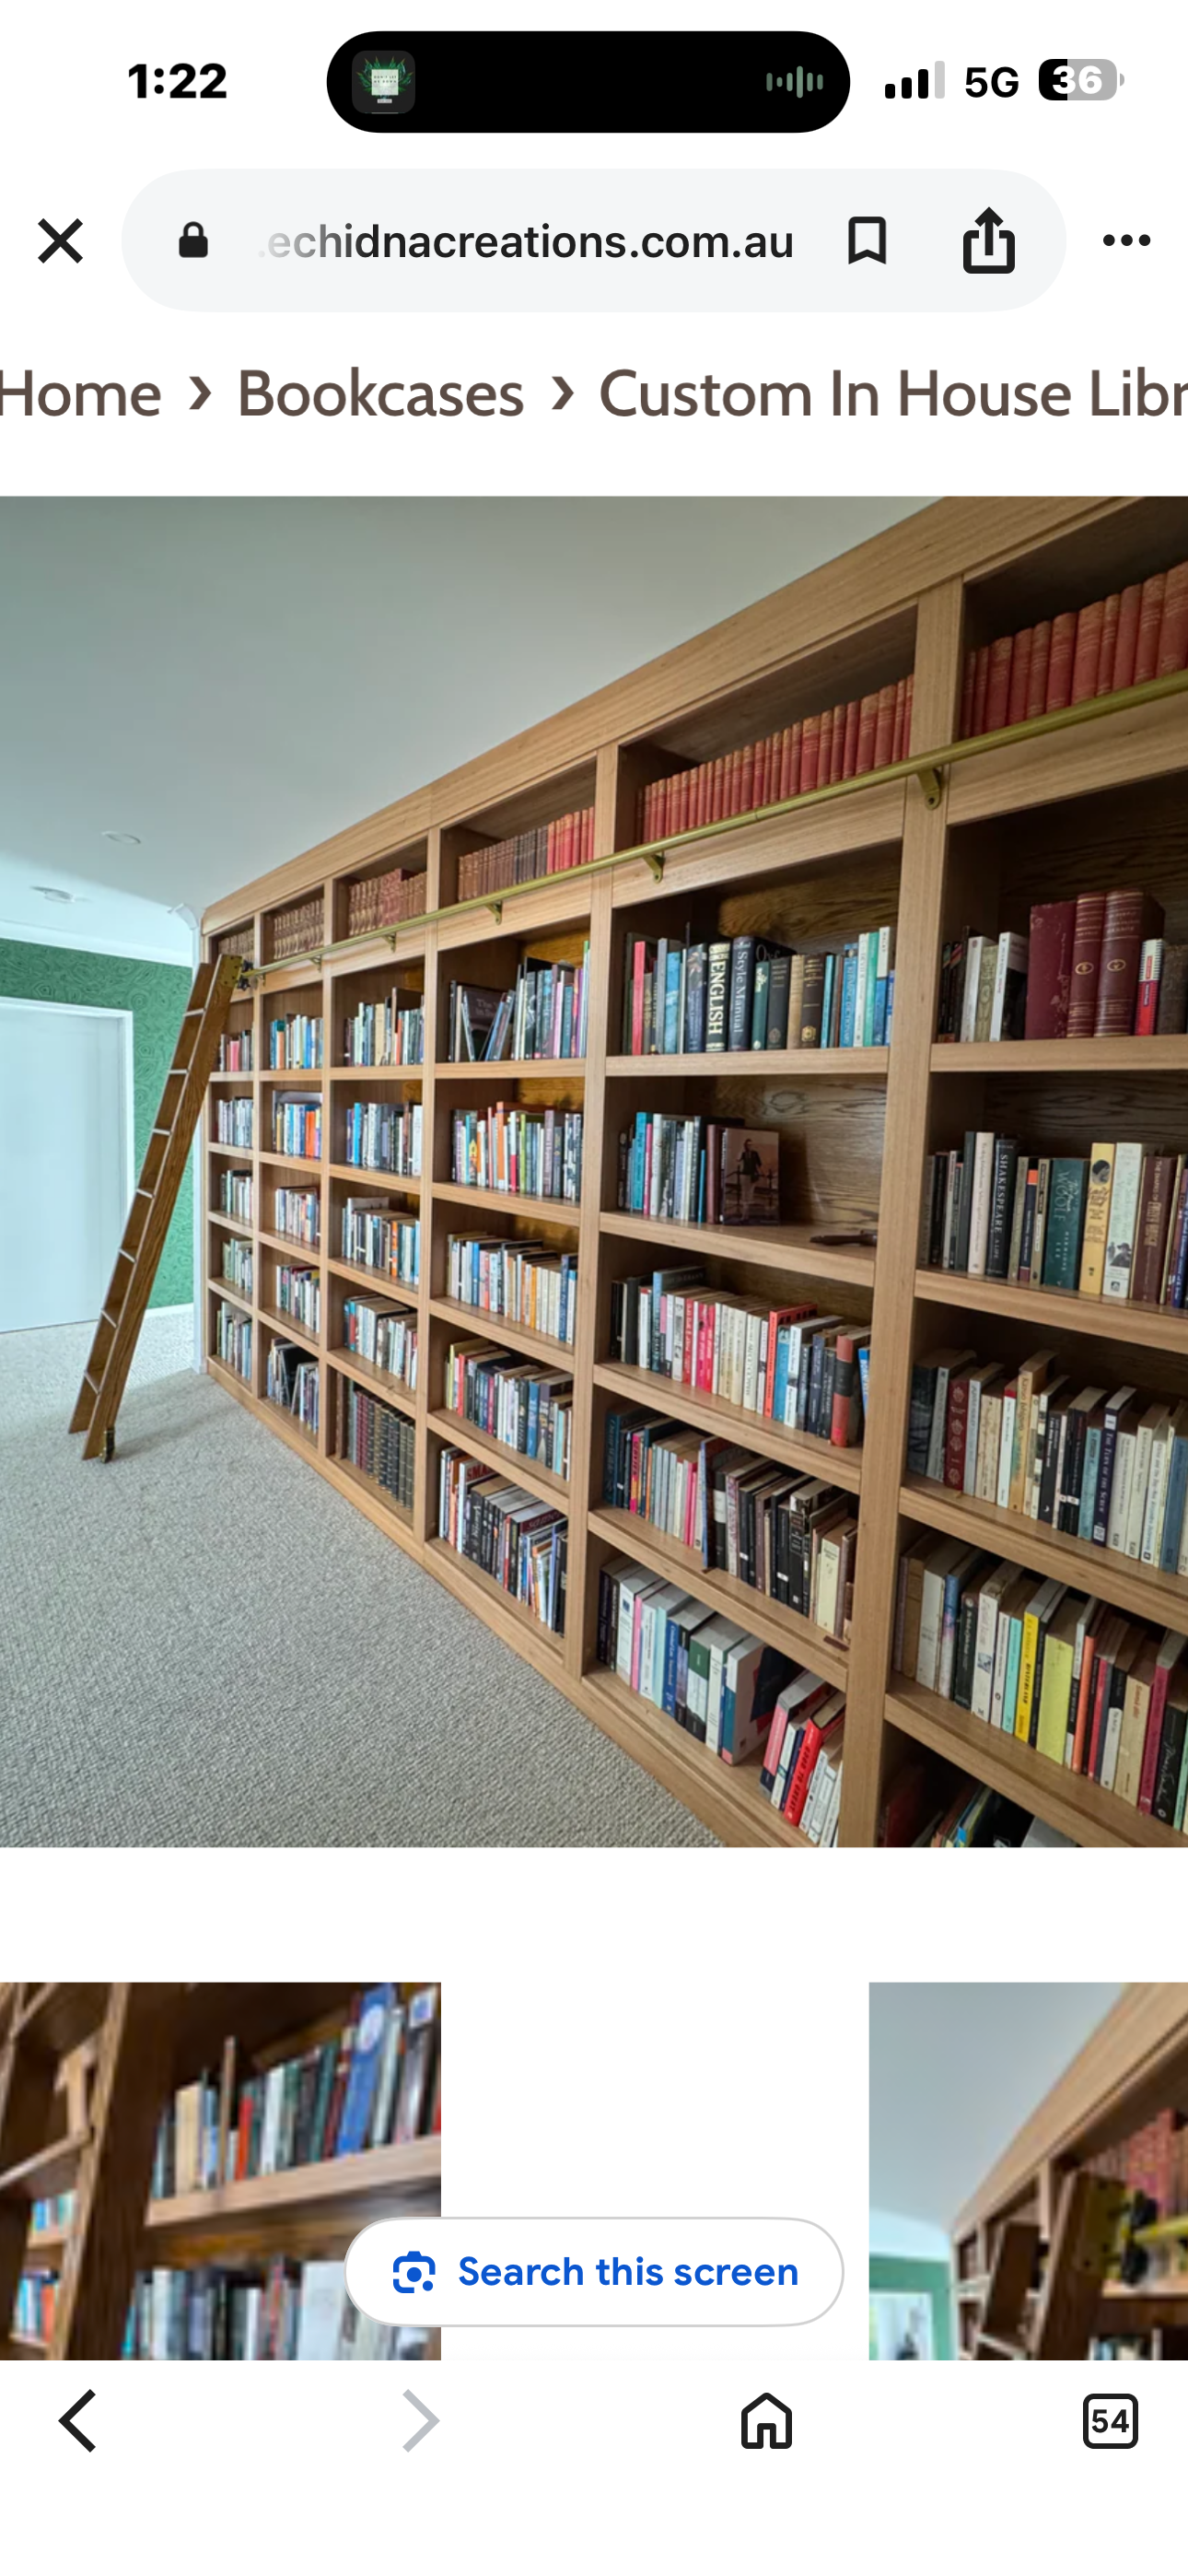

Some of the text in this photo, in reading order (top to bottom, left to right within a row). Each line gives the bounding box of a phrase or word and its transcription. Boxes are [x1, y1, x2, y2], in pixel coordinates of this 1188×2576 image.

[128, 63, 227, 99] 1:22
[965, 65, 1019, 99] 5G
[1052, 64, 1103, 95] 36
[0, 366, 1188, 417] Home Bookcases Custom In House Libr
[708, 960, 727, 1035] ENGLISH
[733, 951, 749, 1033] Style Manual
[994, 1153, 1008, 1234] SHAKESPEARE
[1053, 1171, 1069, 1222] WOOLF
[458, 2255, 798, 2287] Search this screen
[1091, 2408, 1130, 2433] 54
